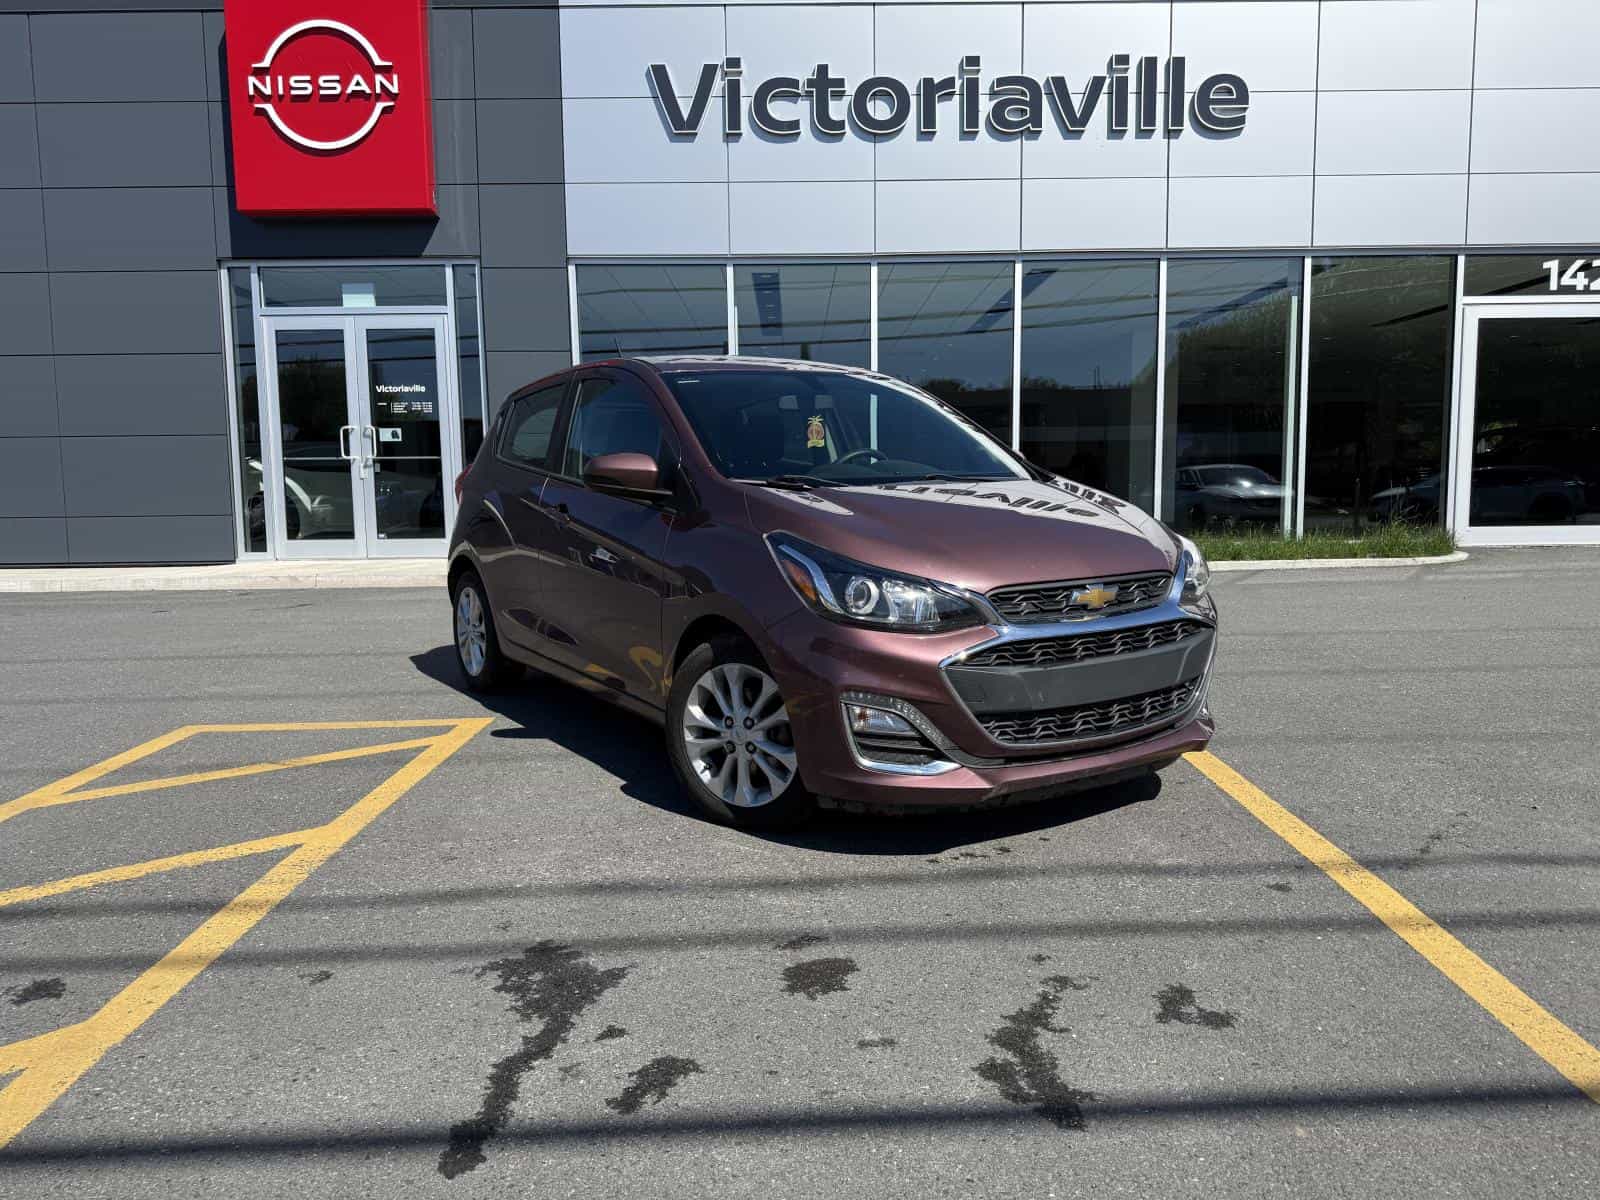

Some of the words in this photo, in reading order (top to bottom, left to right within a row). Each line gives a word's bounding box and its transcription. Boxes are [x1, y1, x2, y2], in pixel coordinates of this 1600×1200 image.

[247, 74, 399, 96] NISSAN
[649, 54, 1250, 136] Victoriaville
[375, 384, 426, 393] Victoriaville
